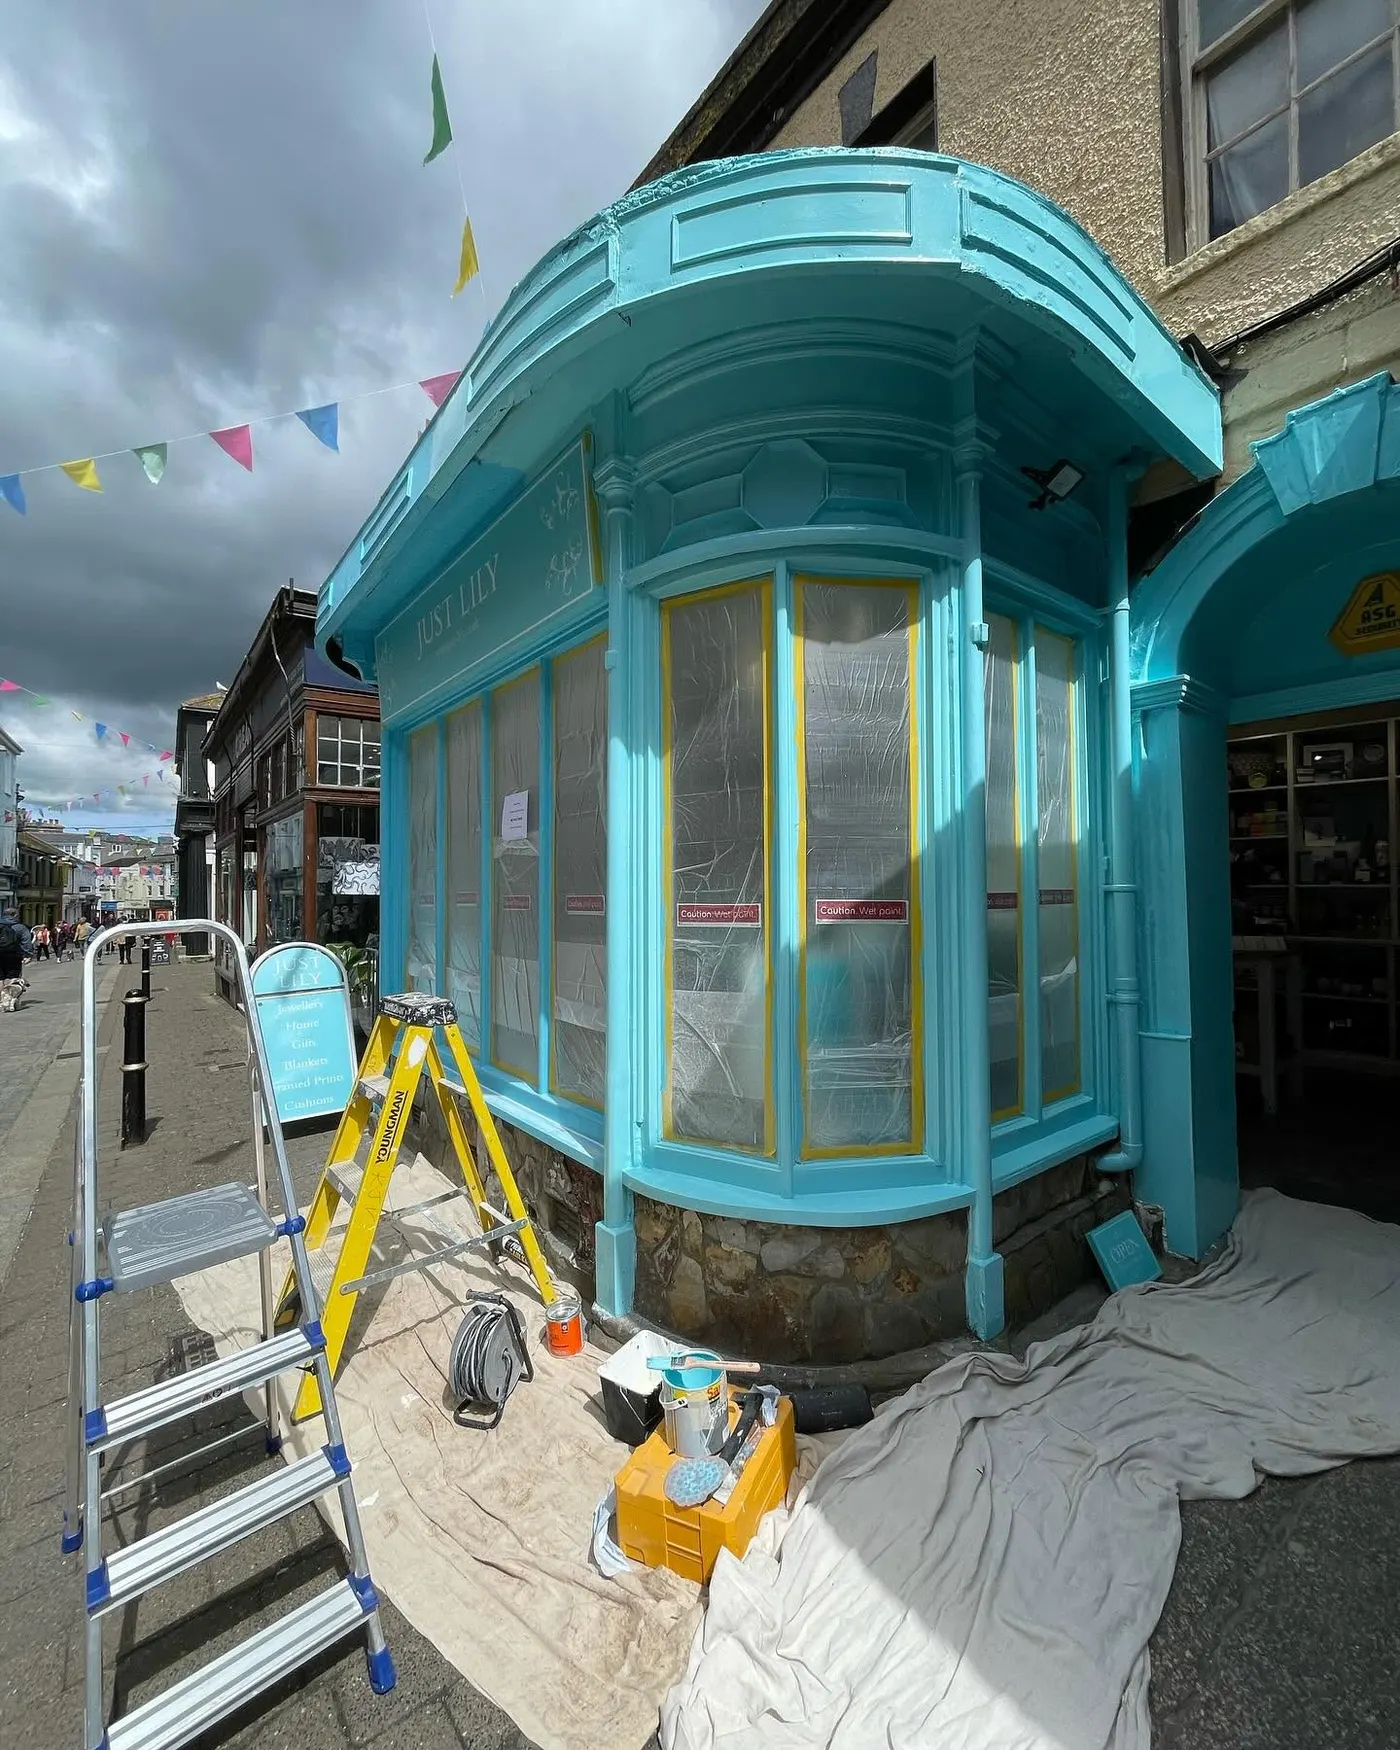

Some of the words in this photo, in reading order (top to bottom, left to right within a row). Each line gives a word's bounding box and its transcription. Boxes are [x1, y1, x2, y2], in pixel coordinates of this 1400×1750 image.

[417, 595, 453, 660] JUST
[459, 553, 499, 617] LILY
[1361, 604, 1396, 623] ASG
[859, 906, 877, 916] Wet
[273, 956, 321, 976] JUST
[280, 972, 322, 988] LILY
[286, 1018, 320, 1031] Home
[291, 1038, 316, 1050] Gifts
[284, 1056, 329, 1071] Blankets
[284, 1096, 334, 1111] Cushions
[375, 1091, 406, 1164] YOUNGMAN
[1110, 1238, 1139, 1264] OPEN
